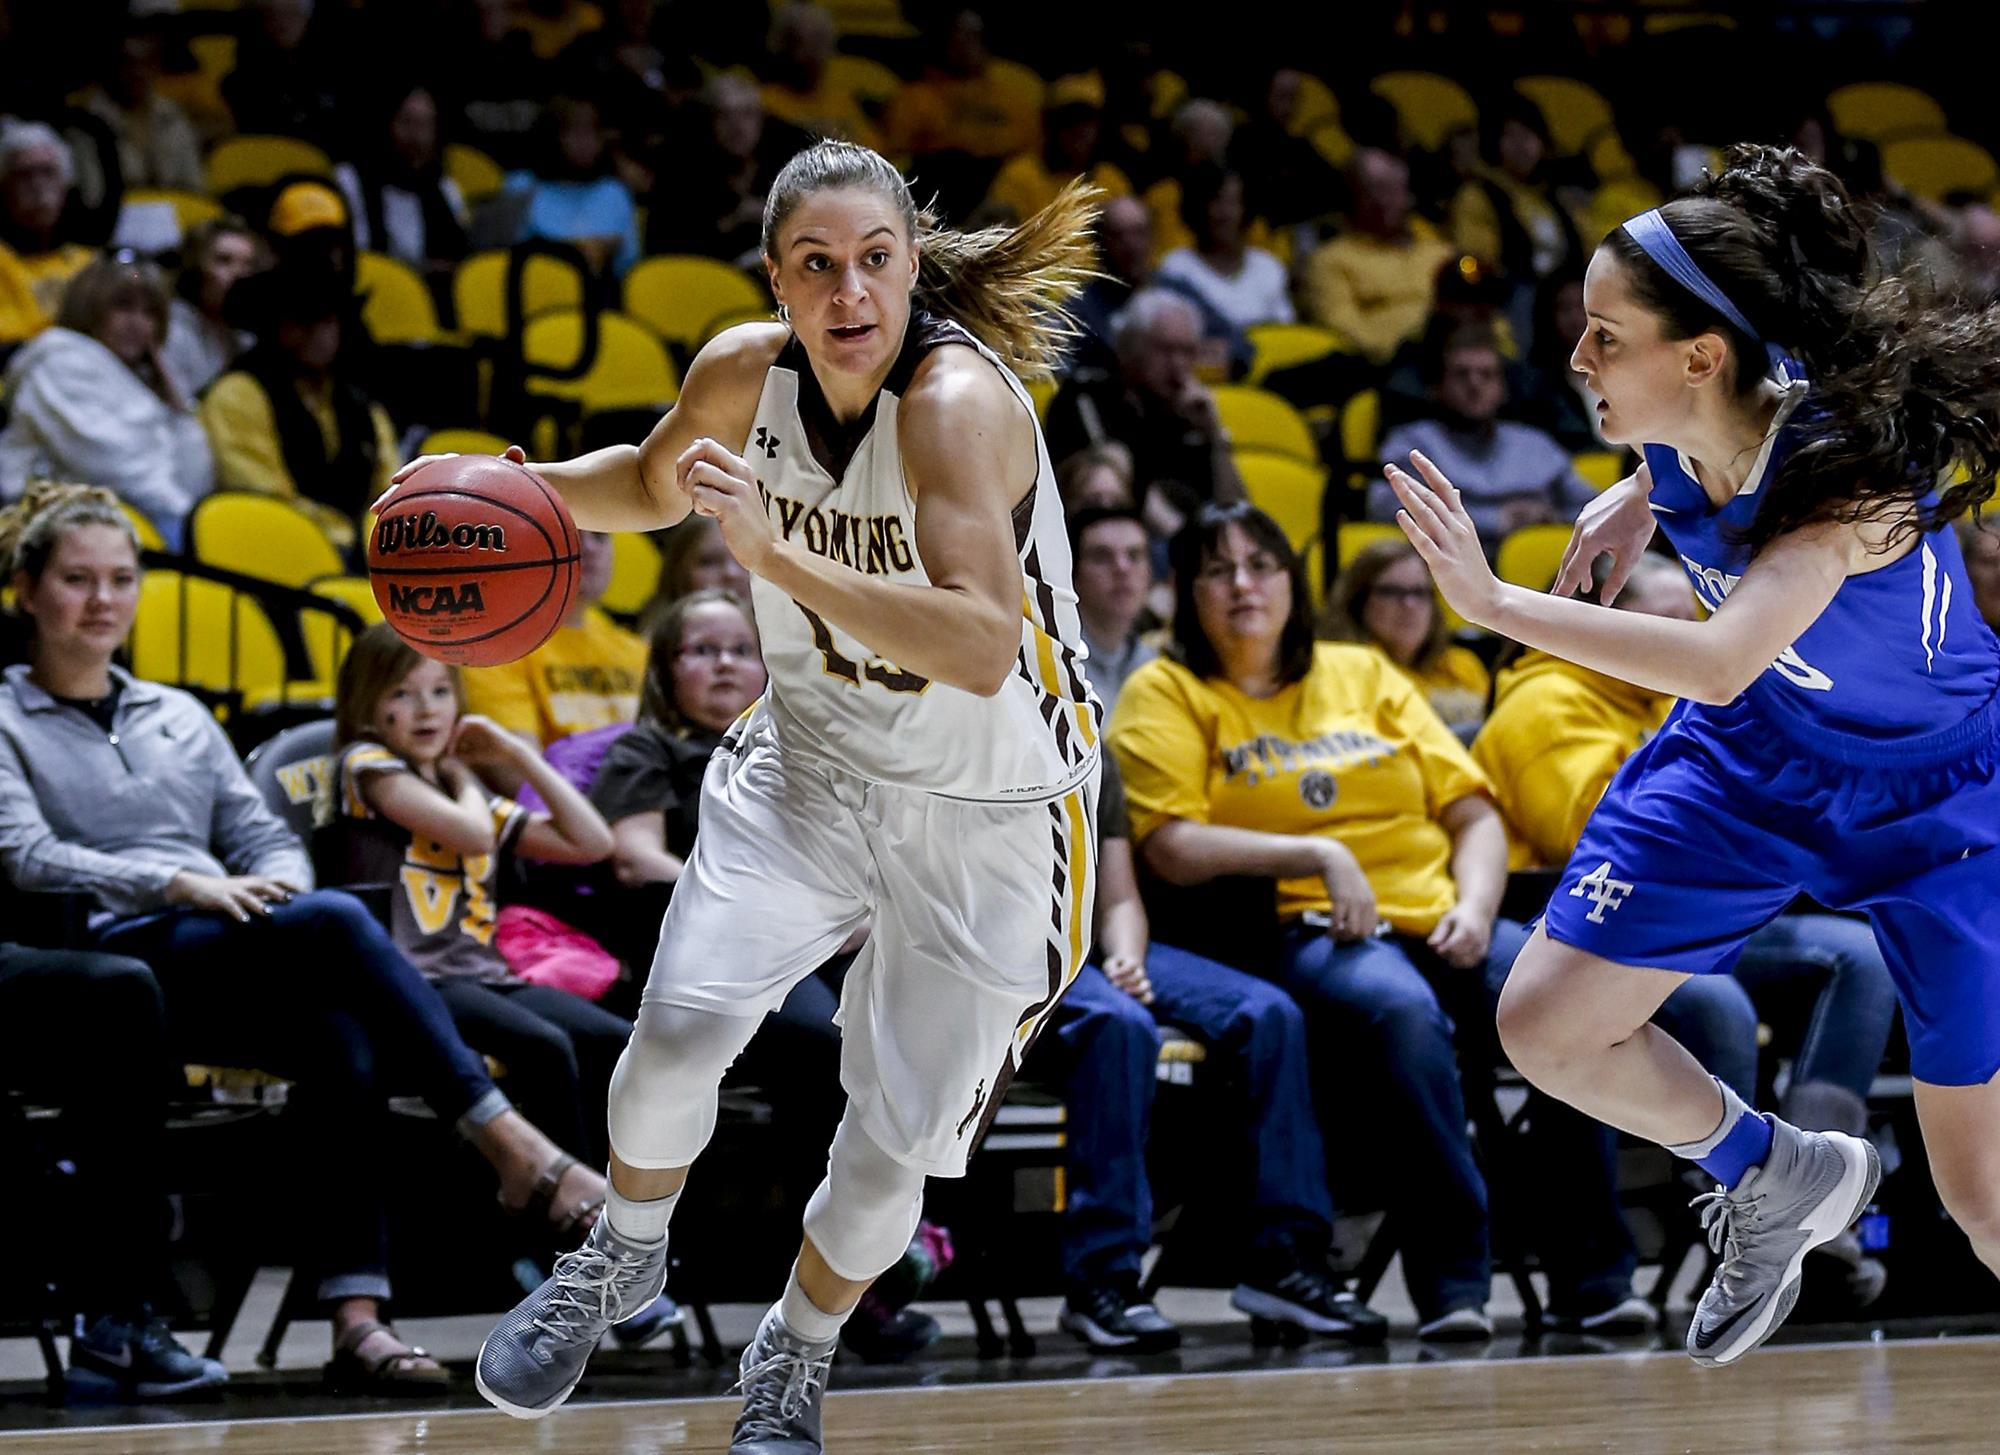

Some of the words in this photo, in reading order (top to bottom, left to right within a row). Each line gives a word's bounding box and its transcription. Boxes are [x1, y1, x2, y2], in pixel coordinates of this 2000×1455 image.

[378, 511, 507, 555] Wilson
[388, 581, 485, 615] NCAA
[1569, 861, 1634, 924] AF
